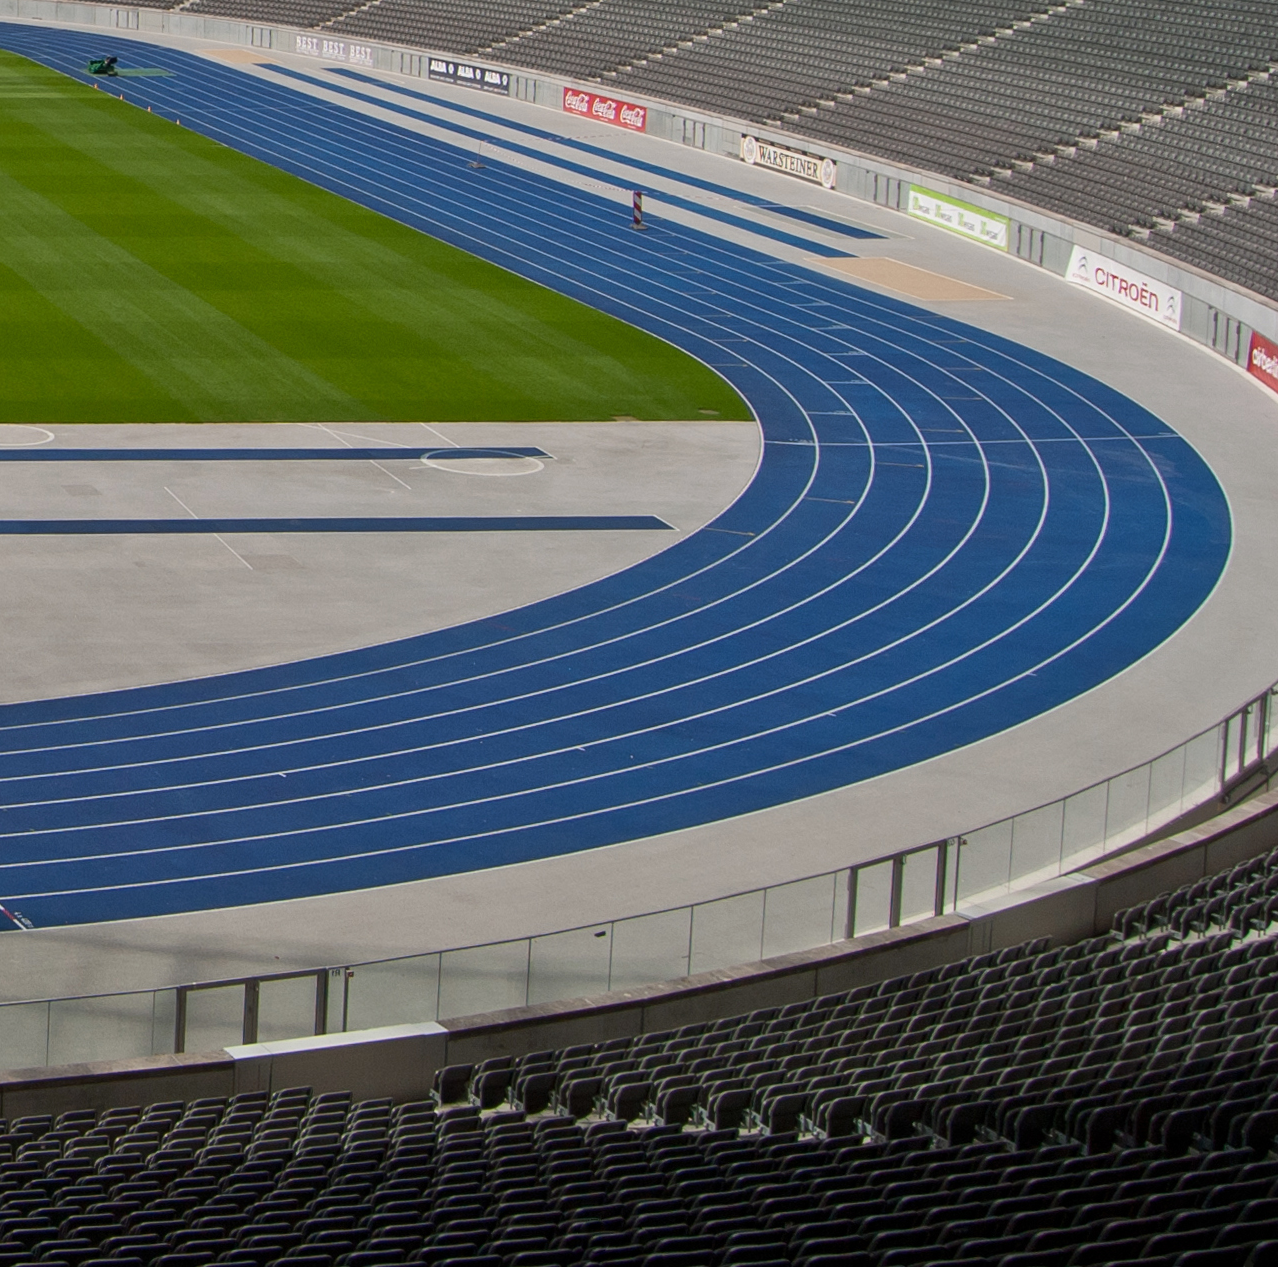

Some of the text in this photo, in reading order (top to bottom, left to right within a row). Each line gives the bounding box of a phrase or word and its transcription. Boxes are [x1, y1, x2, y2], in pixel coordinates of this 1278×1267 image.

[296, 35, 318, 51] BEST
[323, 40, 345, 55] BEST
[350, 45, 372, 60] BEST
[758, 144, 819, 179] WARSTEINER
